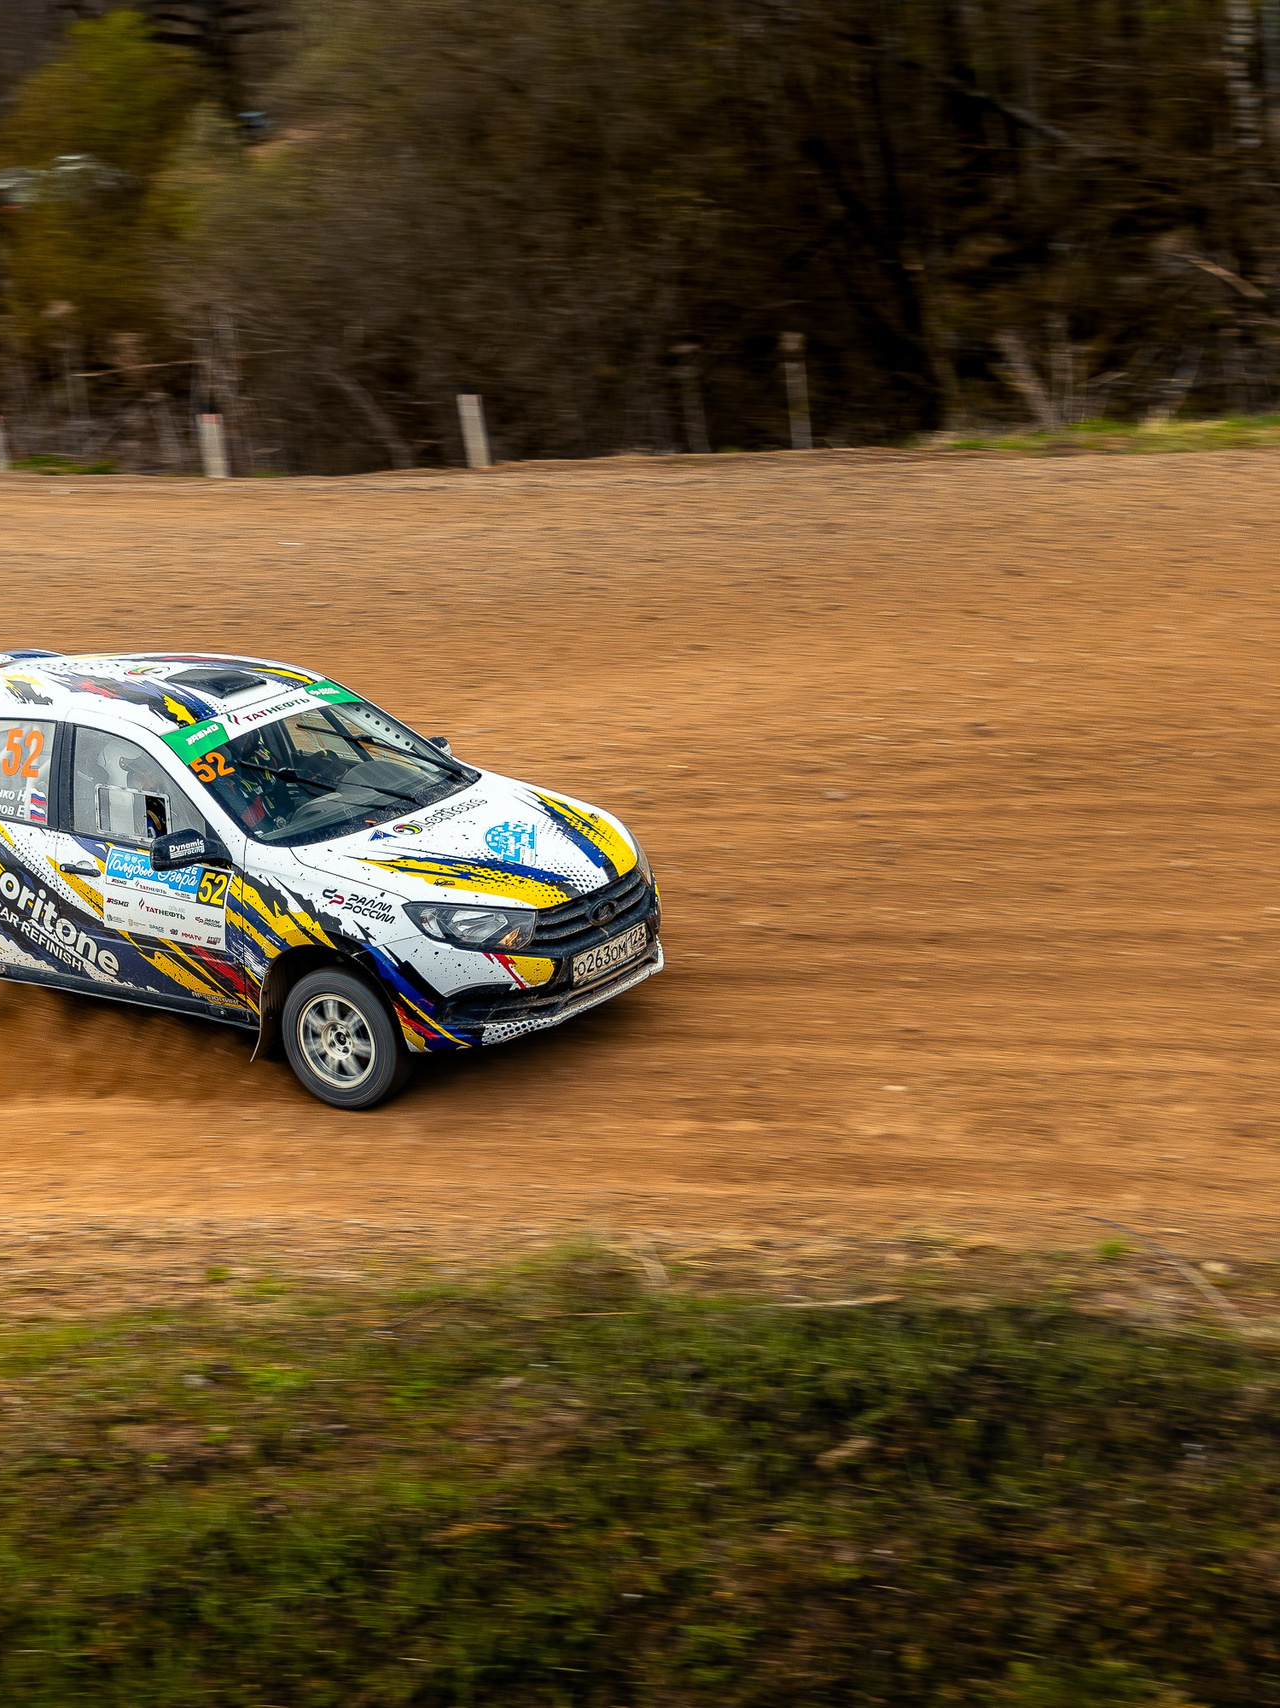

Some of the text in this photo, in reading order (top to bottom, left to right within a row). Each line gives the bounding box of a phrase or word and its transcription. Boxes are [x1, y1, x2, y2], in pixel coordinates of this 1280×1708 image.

[243, 698, 310, 722] ТАТНЕФТЬ
[2, 728, 44, 778] 52
[189, 751, 236, 783] 52
[410, 798, 488, 828] Loritone
[169, 838, 205, 853] Dynamic
[184, 845, 205, 856] racing
[198, 871, 228, 906] 52
[145, 905, 186, 920] ТАТНЕФТЬ
[341, 902, 396, 924] РОССИИ
[348, 893, 393, 913] РАЛЛИ
[21, 921, 83, 972] REFINISH
